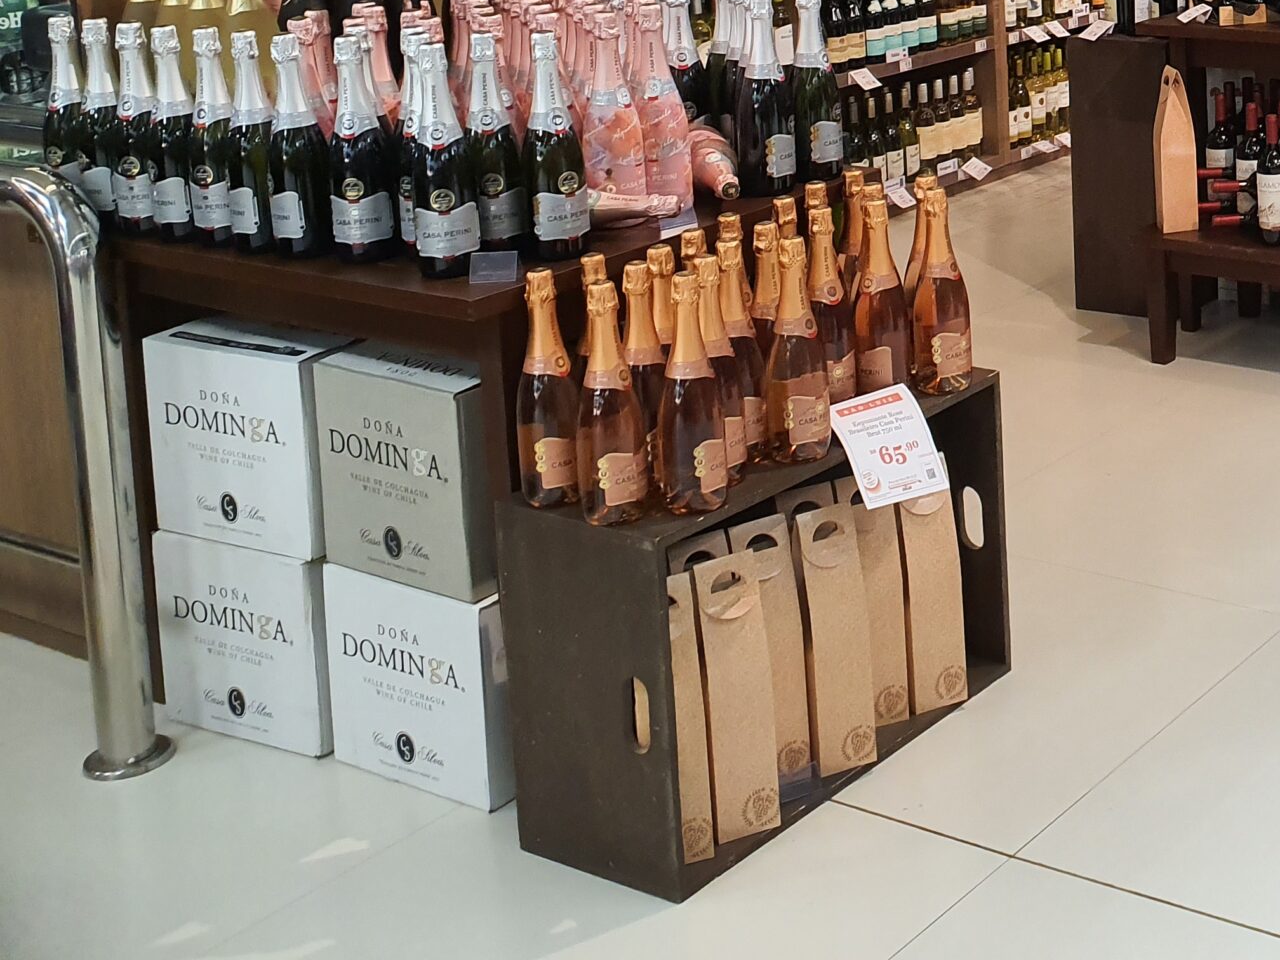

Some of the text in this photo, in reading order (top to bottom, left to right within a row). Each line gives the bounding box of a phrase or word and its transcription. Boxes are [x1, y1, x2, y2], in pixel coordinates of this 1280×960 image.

[335, 216, 383, 227] CASA PERINI
[546, 214, 564, 223] CASA
[422, 227, 472, 240] CASA PERINI
[199, 389, 241, 407] DOÑA
[363, 416, 404, 438] DOÑA
[798, 415, 818, 426] CASA
[895, 414, 914, 424] Perini
[350, 472, 429, 499] VALLE DE COLCHAGUA
[362, 485, 417, 505] WINE OF CHILE
[207, 584, 250, 605] DOÑA
[376, 623, 420, 646] DOÑA
